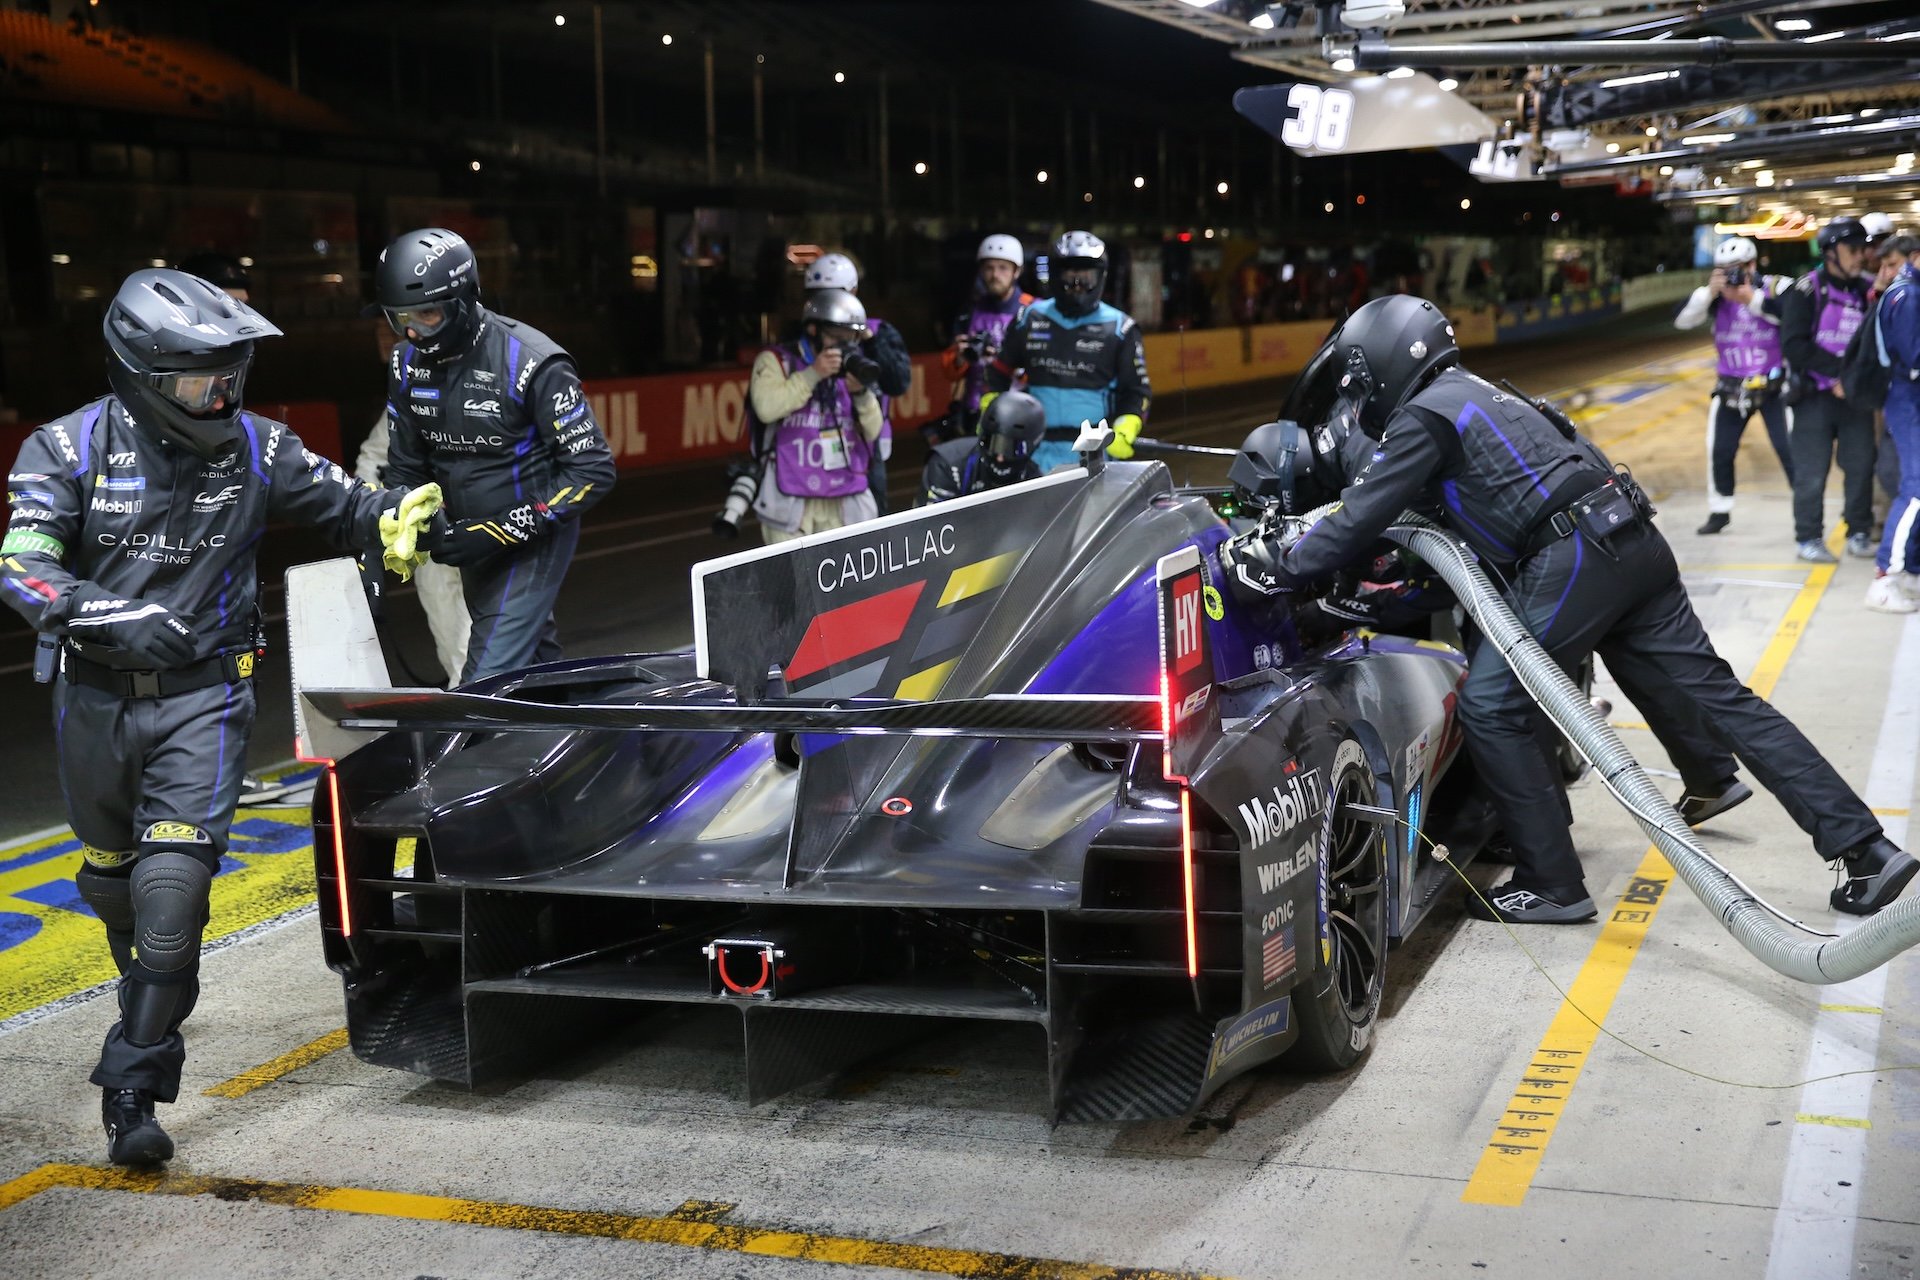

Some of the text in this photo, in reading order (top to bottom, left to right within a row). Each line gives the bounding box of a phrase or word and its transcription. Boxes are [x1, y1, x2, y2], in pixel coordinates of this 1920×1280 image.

[1282, 83, 1355, 152] 38
[463, 382, 501, 395] CADILLC
[516, 358, 537, 393] HRX
[682, 381, 748, 449] MO
[52, 424, 79, 462] HRX
[264, 425, 282, 466] HRX
[91, 496, 133, 514] Mobil
[98, 533, 227, 551] CADILLAC
[127, 550, 192, 565] RACING
[817, 524, 956, 593] CADILLAC
[81, 600, 129, 612] HRX
[1175, 589, 1199, 659] HY
[167, 618, 190, 636] HRX
[1238, 776, 1308, 850] Mobil
[1257, 832, 1318, 895] WHELEN
[1319, 790, 1333, 914] MICHELIN
[1262, 900, 1294, 936] SONIC
[1226, 1011, 1280, 1051] MICHELIN
